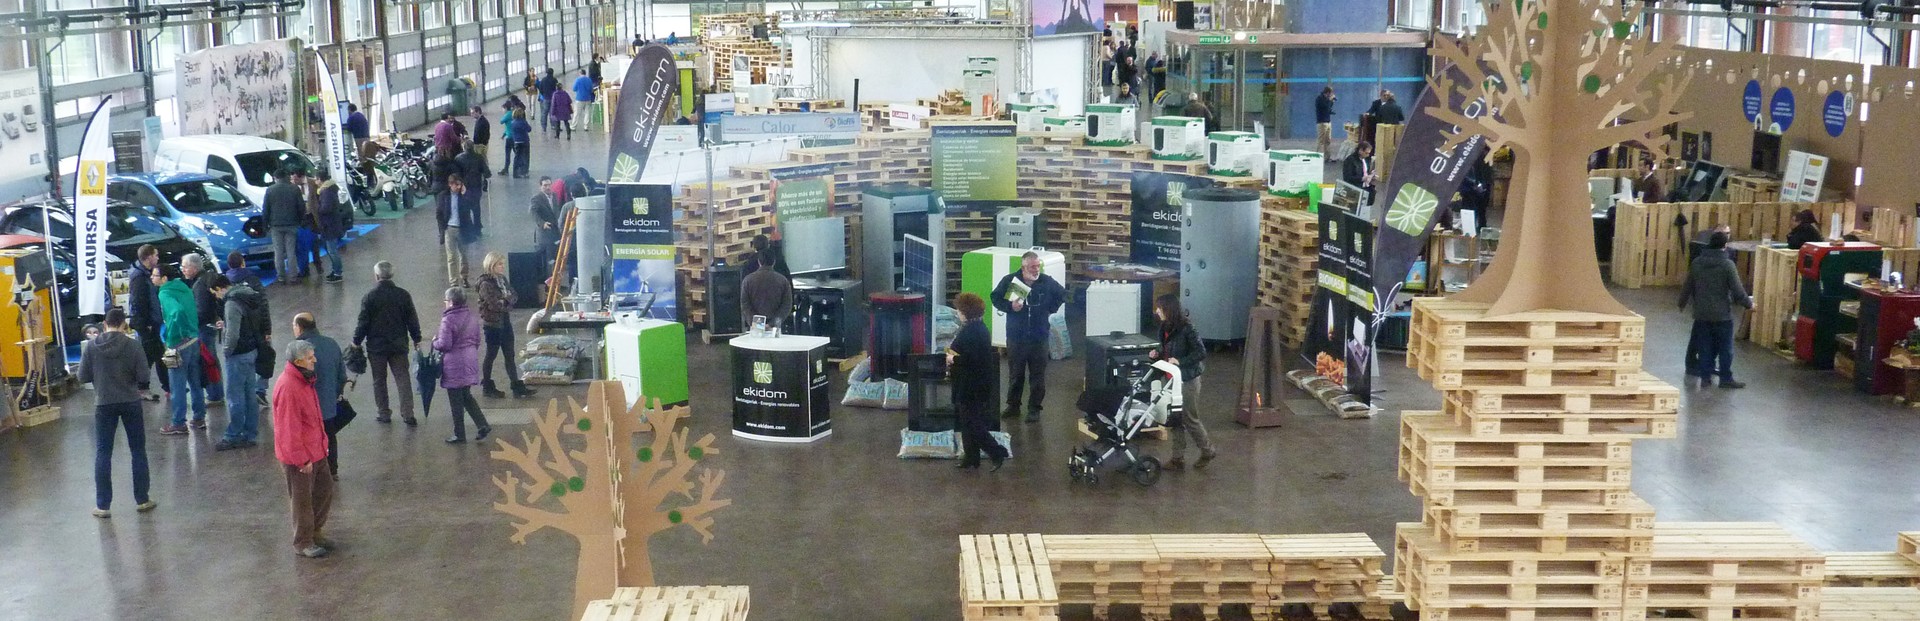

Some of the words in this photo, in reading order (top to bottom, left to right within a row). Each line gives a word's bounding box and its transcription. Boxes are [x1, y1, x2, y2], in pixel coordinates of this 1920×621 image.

[632, 57, 670, 143] ekidom
[643, 83, 670, 148] www.ekidom.com
[761, 120, 796, 134] Calor
[623, 218, 660, 226] ekidom
[85, 208, 98, 281] GAURSA
[1322, 242, 1342, 255] ekidom
[1349, 255, 1366, 268] ekidom
[812, 374, 826, 384] ekidom
[743, 386, 787, 399] ekidom
[746, 422, 786, 430] www.ekidom.com
